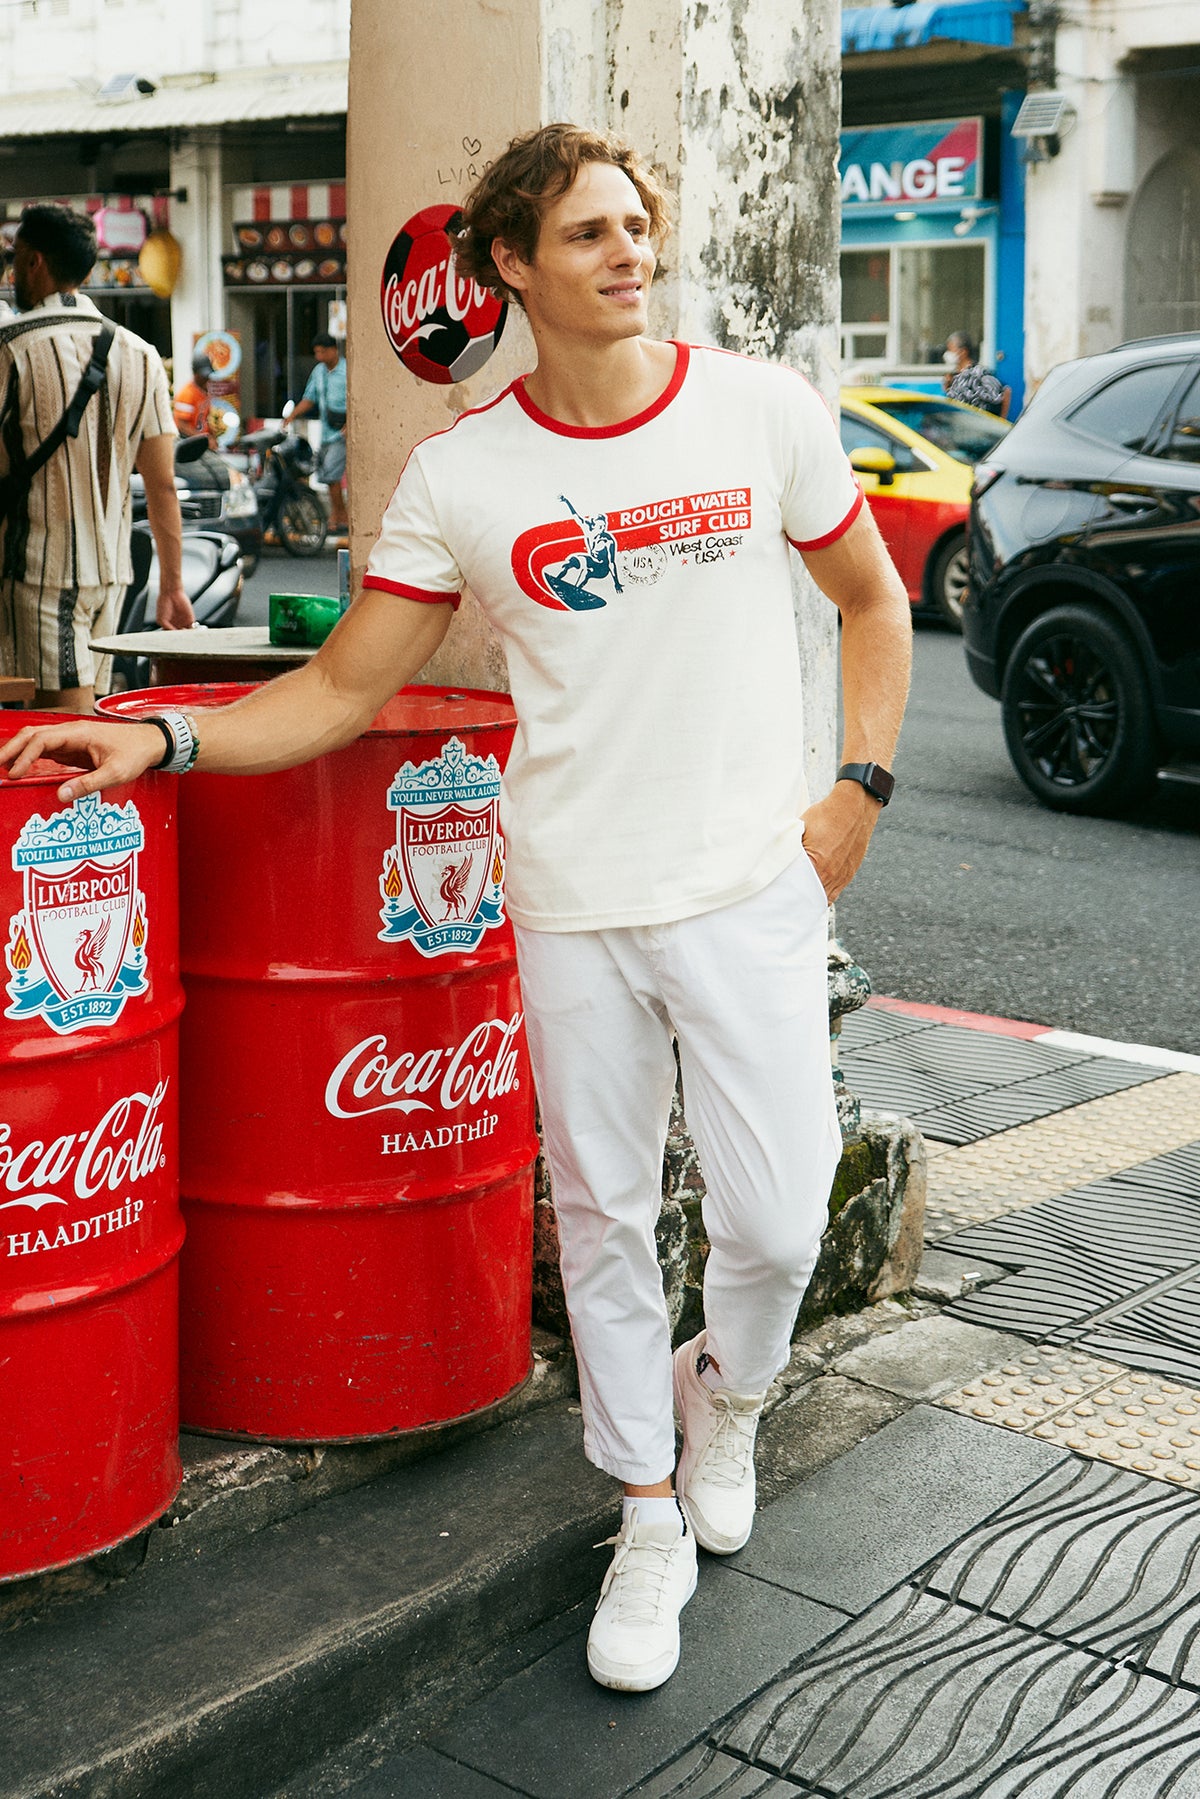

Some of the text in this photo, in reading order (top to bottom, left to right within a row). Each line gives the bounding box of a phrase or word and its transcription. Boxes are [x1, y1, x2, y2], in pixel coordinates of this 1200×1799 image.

[842, 157, 965, 200] ANGE
[620, 490, 748, 527] ROUGH WATER
[659, 512, 749, 540] SURF CLUB
[669, 539, 702, 556] West
[705, 534, 744, 548] Coast
[695, 549, 725, 564] USA
[633, 557, 653, 569] USA
[393, 784, 500, 803] YOU'LL NEVER WALK ALONE
[409, 817, 490, 843] LIVERPOOL
[19, 835, 140, 863] YOU'LL NEVER WALK ALONE
[412, 840, 487, 857] FOOTBALL CLUB
[38, 872, 129, 907] LIVERPOOL
[42, 898, 126, 922] FOOTBALL CLUB
[325, 1011, 525, 1119] Coca-Cola
